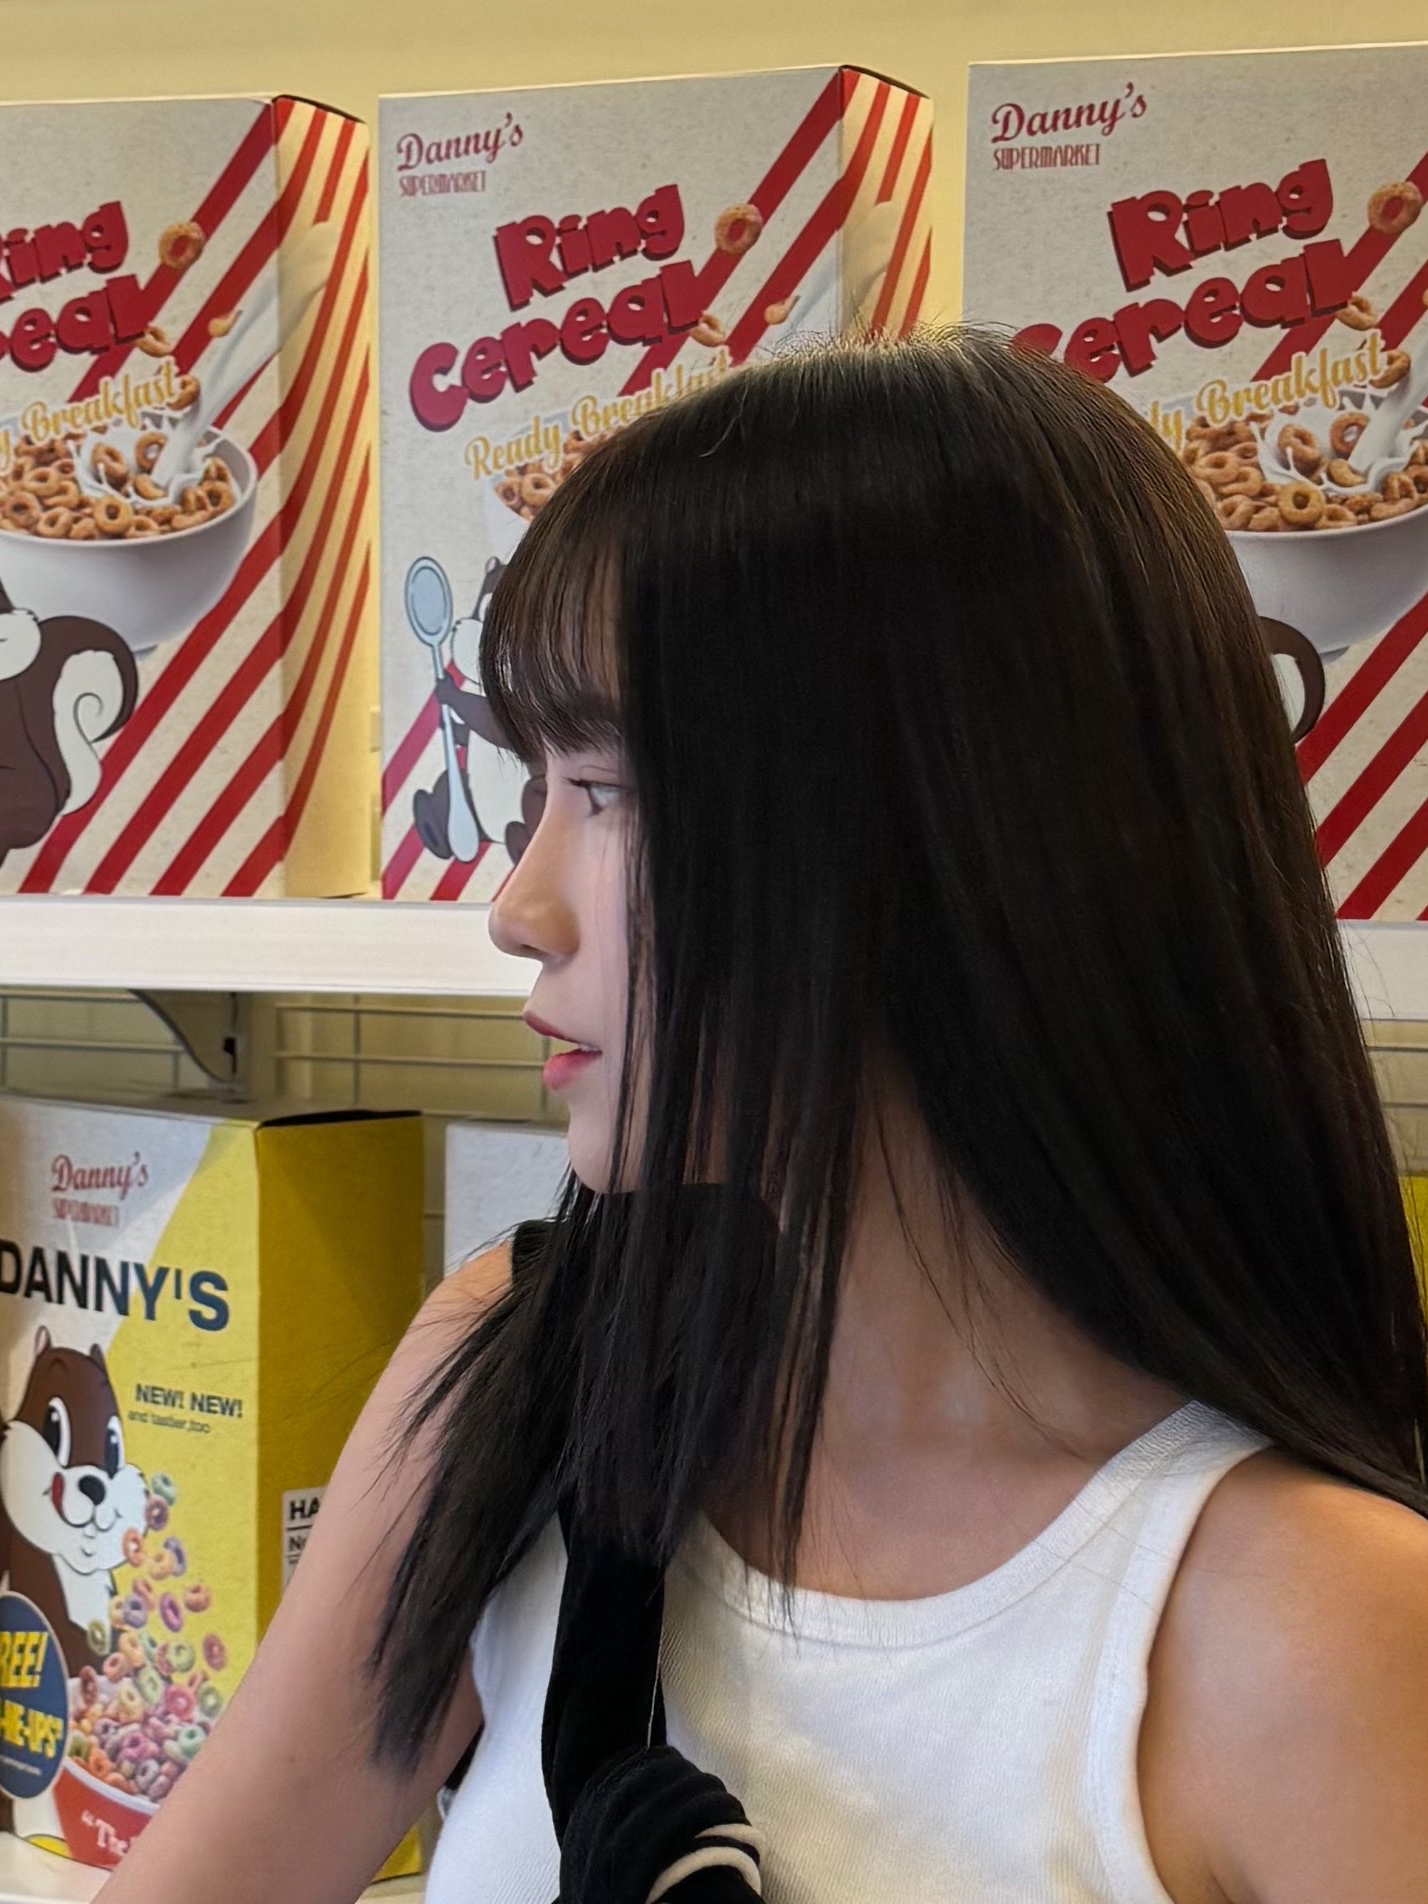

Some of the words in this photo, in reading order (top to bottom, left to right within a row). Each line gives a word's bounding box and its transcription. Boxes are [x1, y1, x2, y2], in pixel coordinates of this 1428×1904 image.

[396, 113, 523, 171] Danny's
[991, 81, 1147, 143] Danny's
[993, 143, 1101, 171] SUPERMARKET
[493, 185, 686, 309] Ring
[1108, 159, 1333, 291] Ring
[409, 262, 711, 433] Cereal
[21, 369, 178, 434] Breakfast
[1194, 334, 1386, 425] Breakfast
[465, 423, 565, 479] Ready
[50, 1151, 149, 1195] Danny's
[135, 1383, 185, 1411] NEW!
[190, 1391, 242, 1419] NEW!
